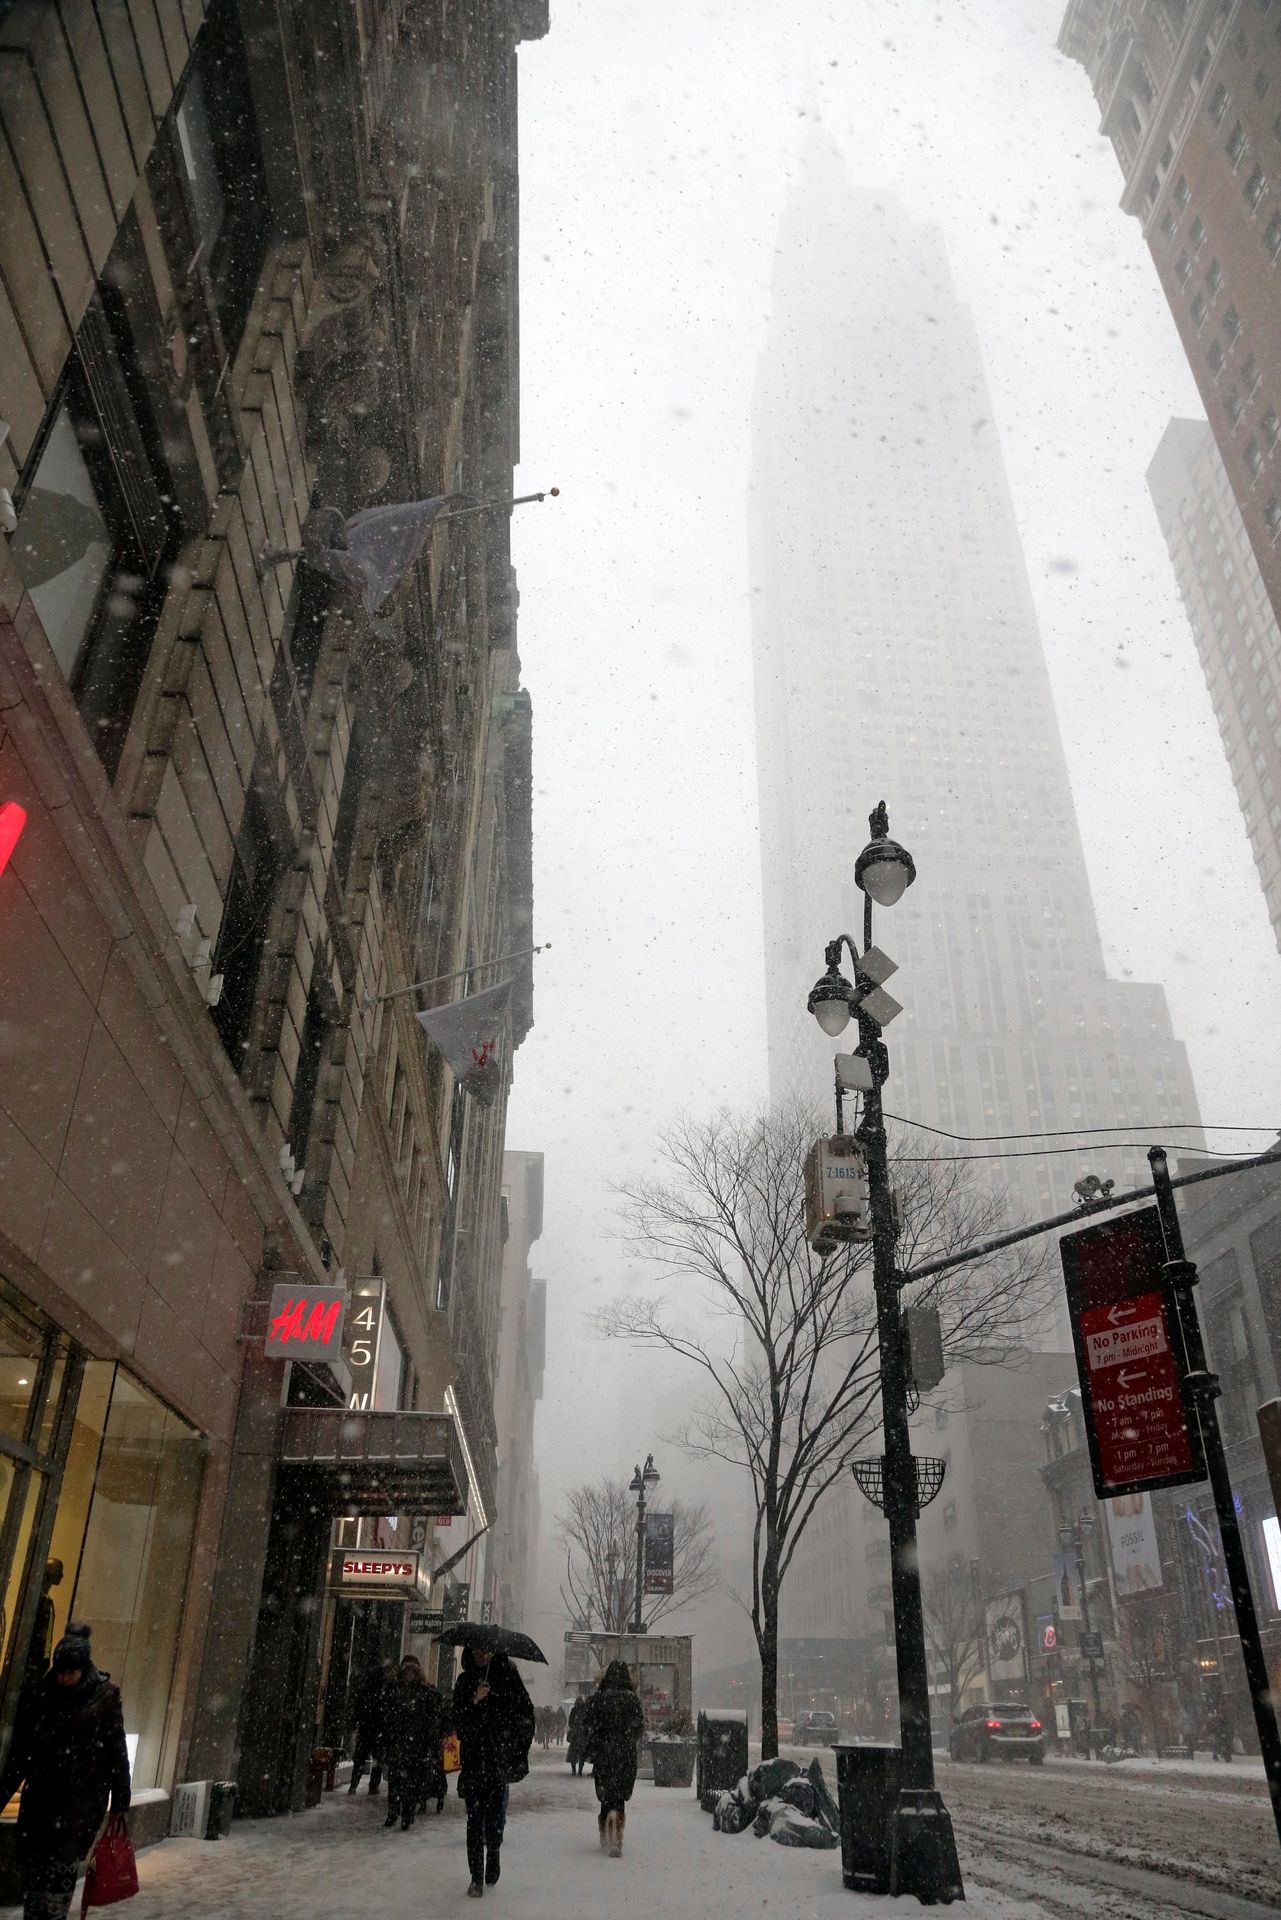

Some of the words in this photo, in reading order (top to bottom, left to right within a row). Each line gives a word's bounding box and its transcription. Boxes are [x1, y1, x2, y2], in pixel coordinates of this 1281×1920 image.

[269, 1299, 342, 1345] H&M
[1092, 1337, 1110, 1350] No
[1112, 1323, 1158, 1345] Parking
[1096, 1355, 1101, 1365] 7
[1103, 1354, 1116, 1366] pm
[1122, 1341, 1159, 1359] Midnight
[1097, 1398, 1115, 1413] No
[1117, 1386, 1174, 1409] Standing
[1111, 1417, 1117, 1428] 7
[1119, 1416, 1133, 1425] am
[1142, 1410, 1148, 1421] 7
[1150, 1409, 1164, 1422] pm
[1146, 1422, 1168, 1434] Friday
[1123, 1449, 1137, 1461] pm
[1147, 1443, 1153, 1454] 7
[1155, 1442, 1169, 1455] pm
[1113, 1461, 1144, 1475] Saturday
[1150, 1454, 1177, 1467] Sunday
[1120, 1529, 1145, 1548] FOSSIL
[460, 1589, 468, 1622] ZARA
